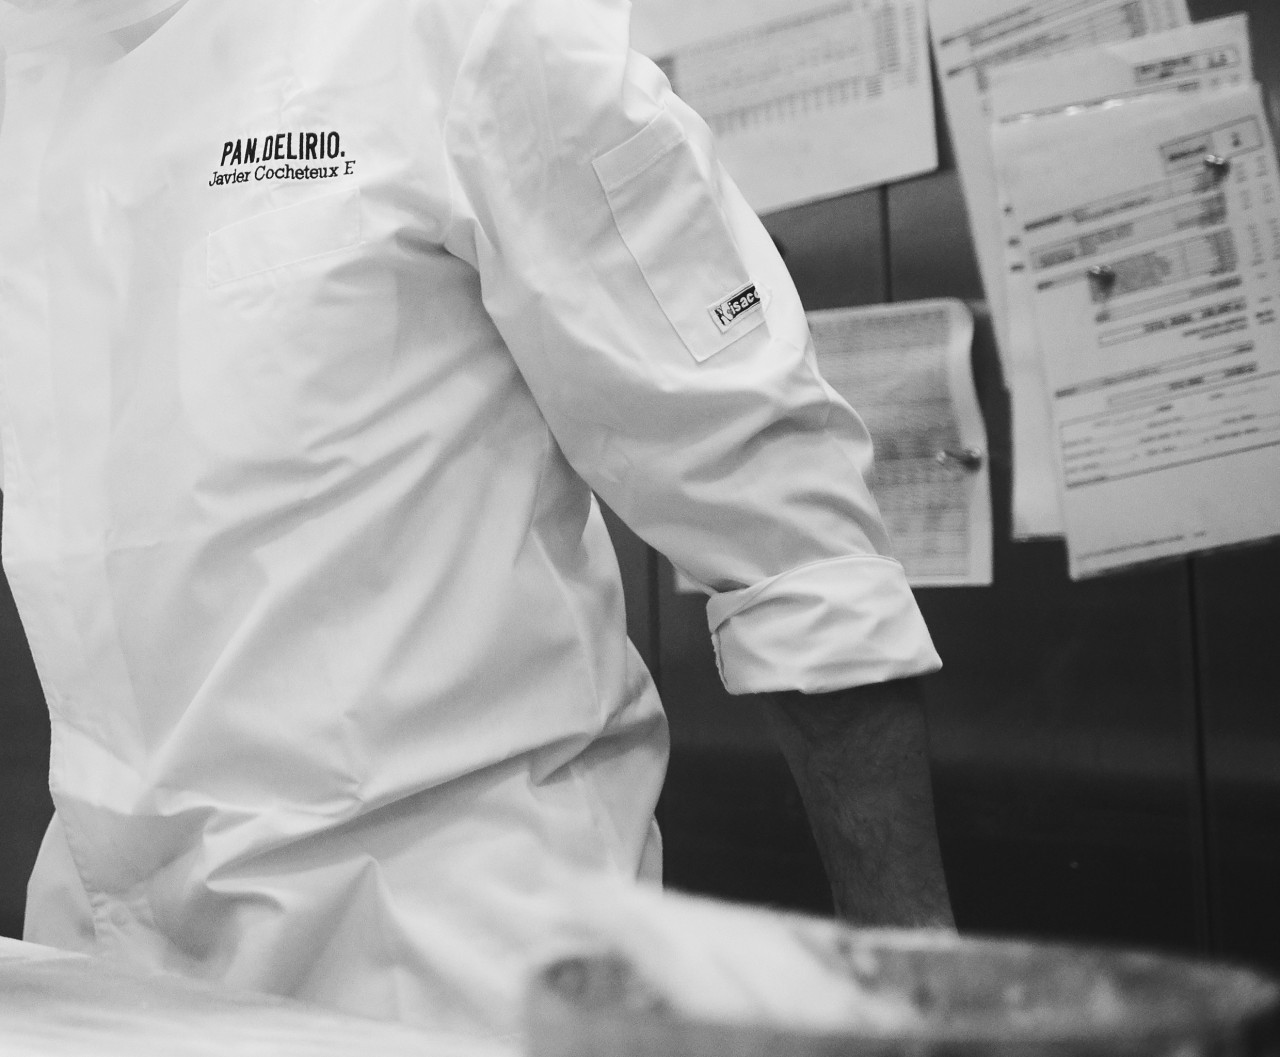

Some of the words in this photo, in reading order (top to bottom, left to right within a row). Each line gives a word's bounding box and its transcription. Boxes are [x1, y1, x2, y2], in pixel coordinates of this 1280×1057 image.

[220, 131, 346, 166] PAN.DELIRIO.
[208, 168, 252, 187] Javier
[254, 163, 340, 181] Cocheteux
